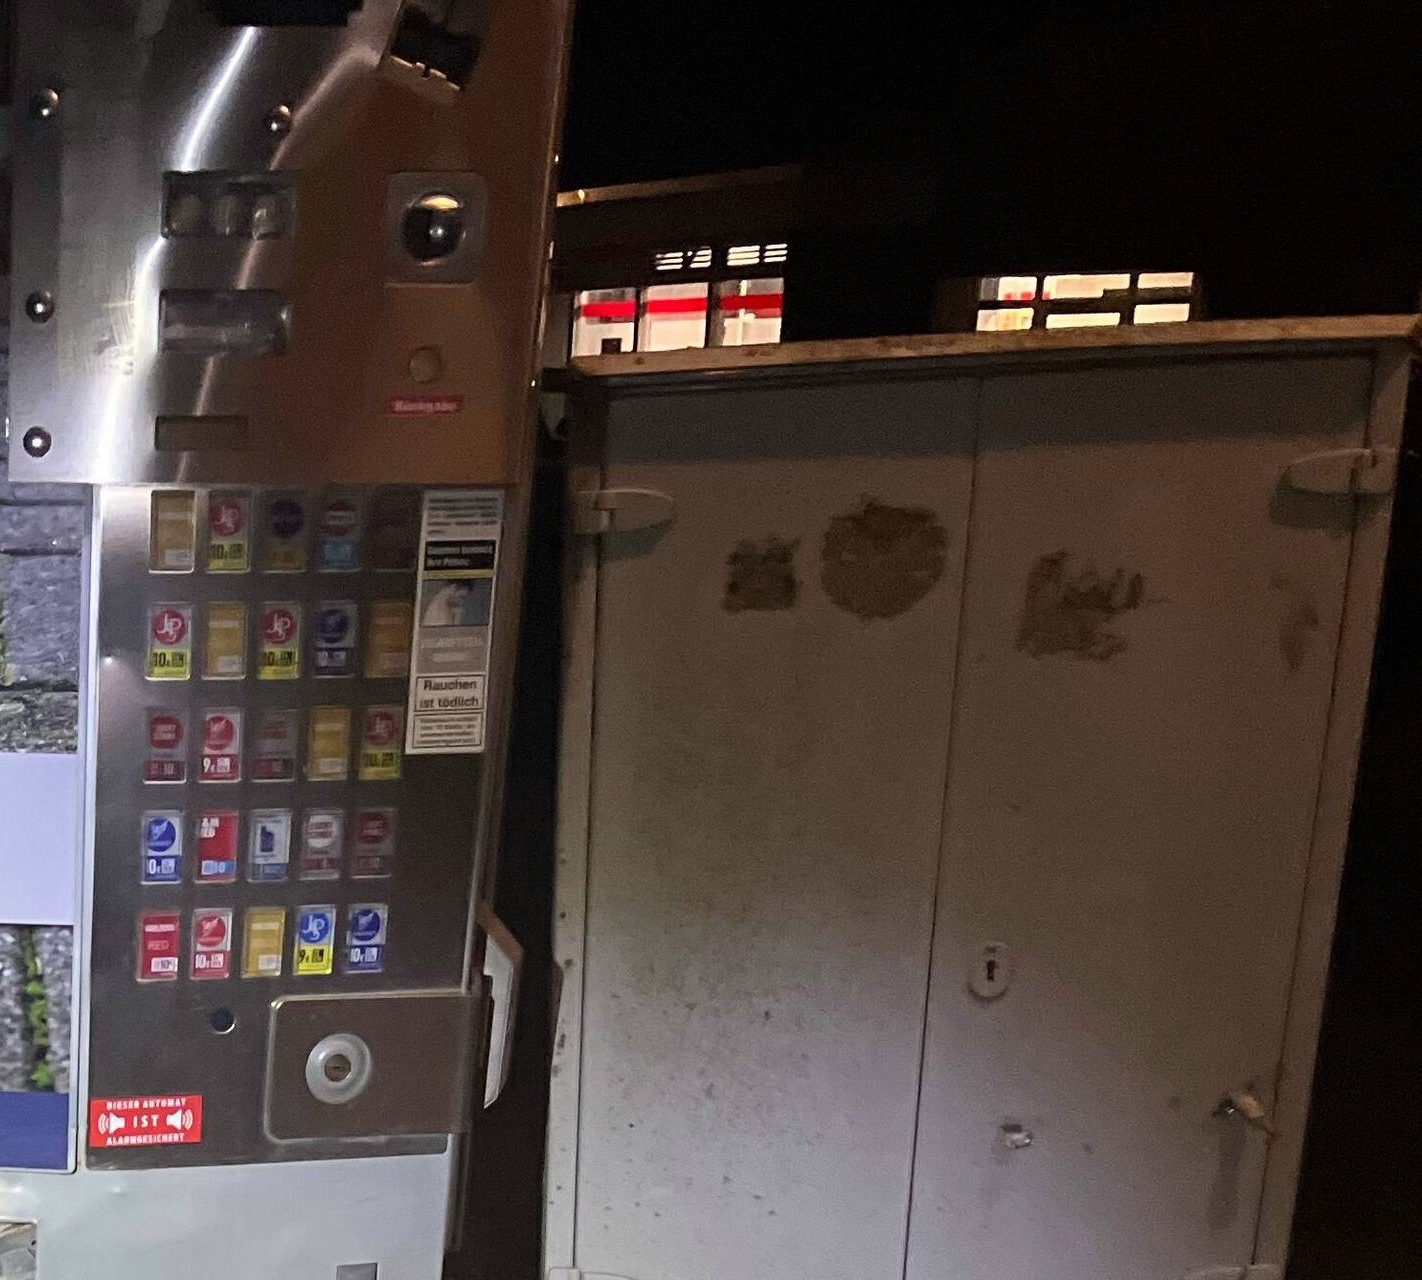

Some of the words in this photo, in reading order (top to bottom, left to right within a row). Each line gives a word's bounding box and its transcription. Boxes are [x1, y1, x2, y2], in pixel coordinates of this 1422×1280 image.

[423, 677, 478, 691] Rauchen
[419, 696, 435, 709] ist
[438, 694, 480, 709] tödlich
[106, 1100, 140, 1111] DIESER
[142, 1098, 187, 1109] AUTOMAT
[132, 1114, 160, 1129] IST
[105, 1132, 186, 1146] ALARMGESICHERT
